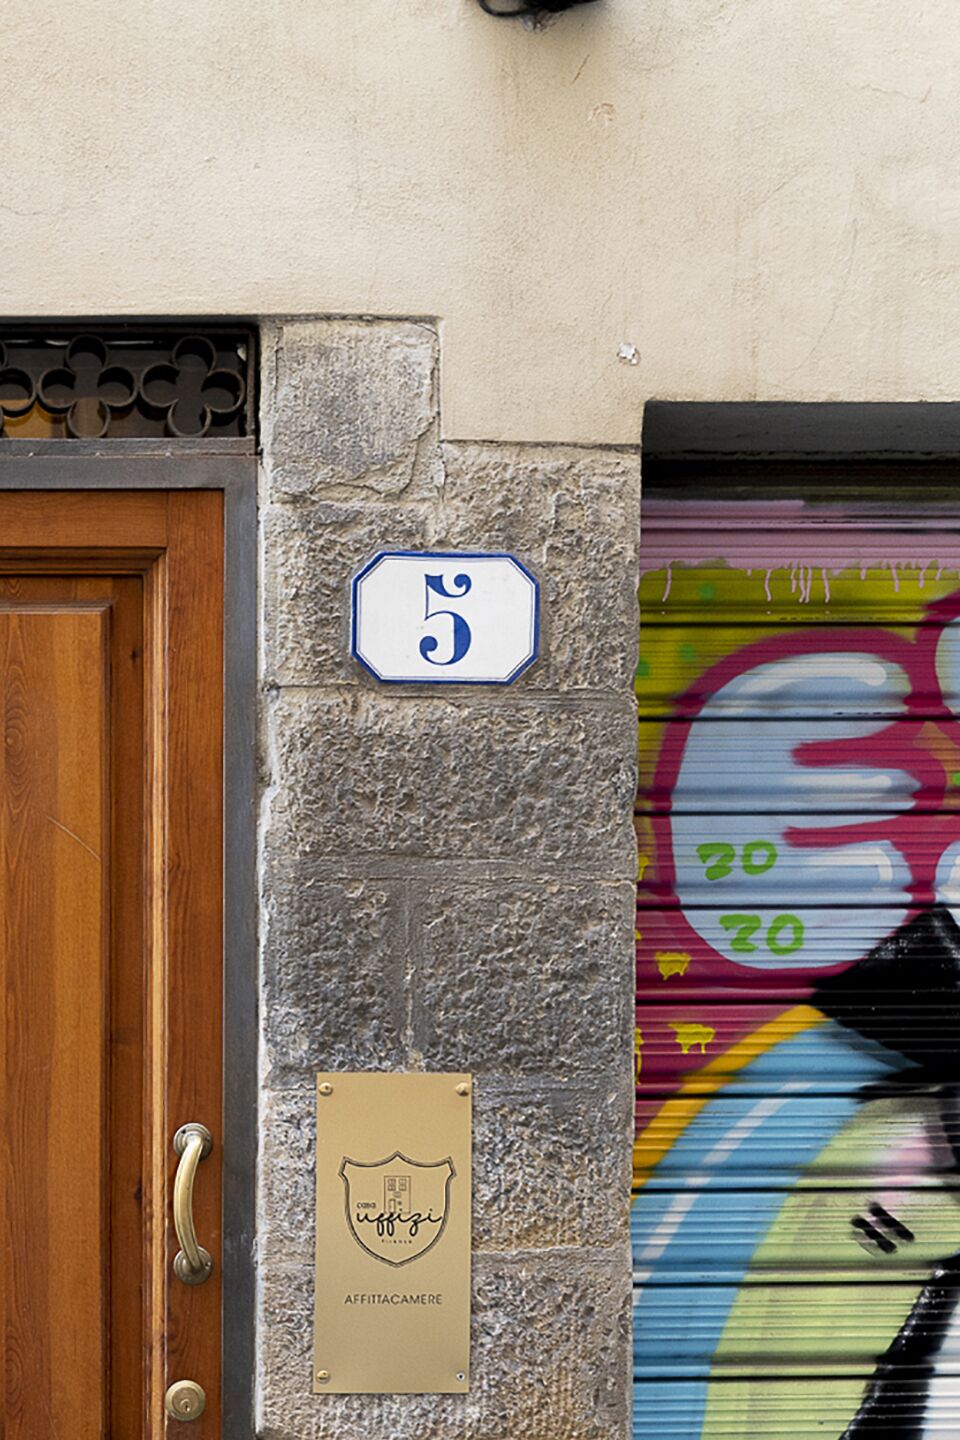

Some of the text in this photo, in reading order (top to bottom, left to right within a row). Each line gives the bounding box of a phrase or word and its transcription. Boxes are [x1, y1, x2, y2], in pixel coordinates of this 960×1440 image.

[419, 573, 472, 666] 5
[696, 840, 778, 881] 20
[719, 913, 805, 956] 20
[356, 1208, 442, 1237] uffizi
[344, 1294, 442, 1305] AFFITTACAMERE
